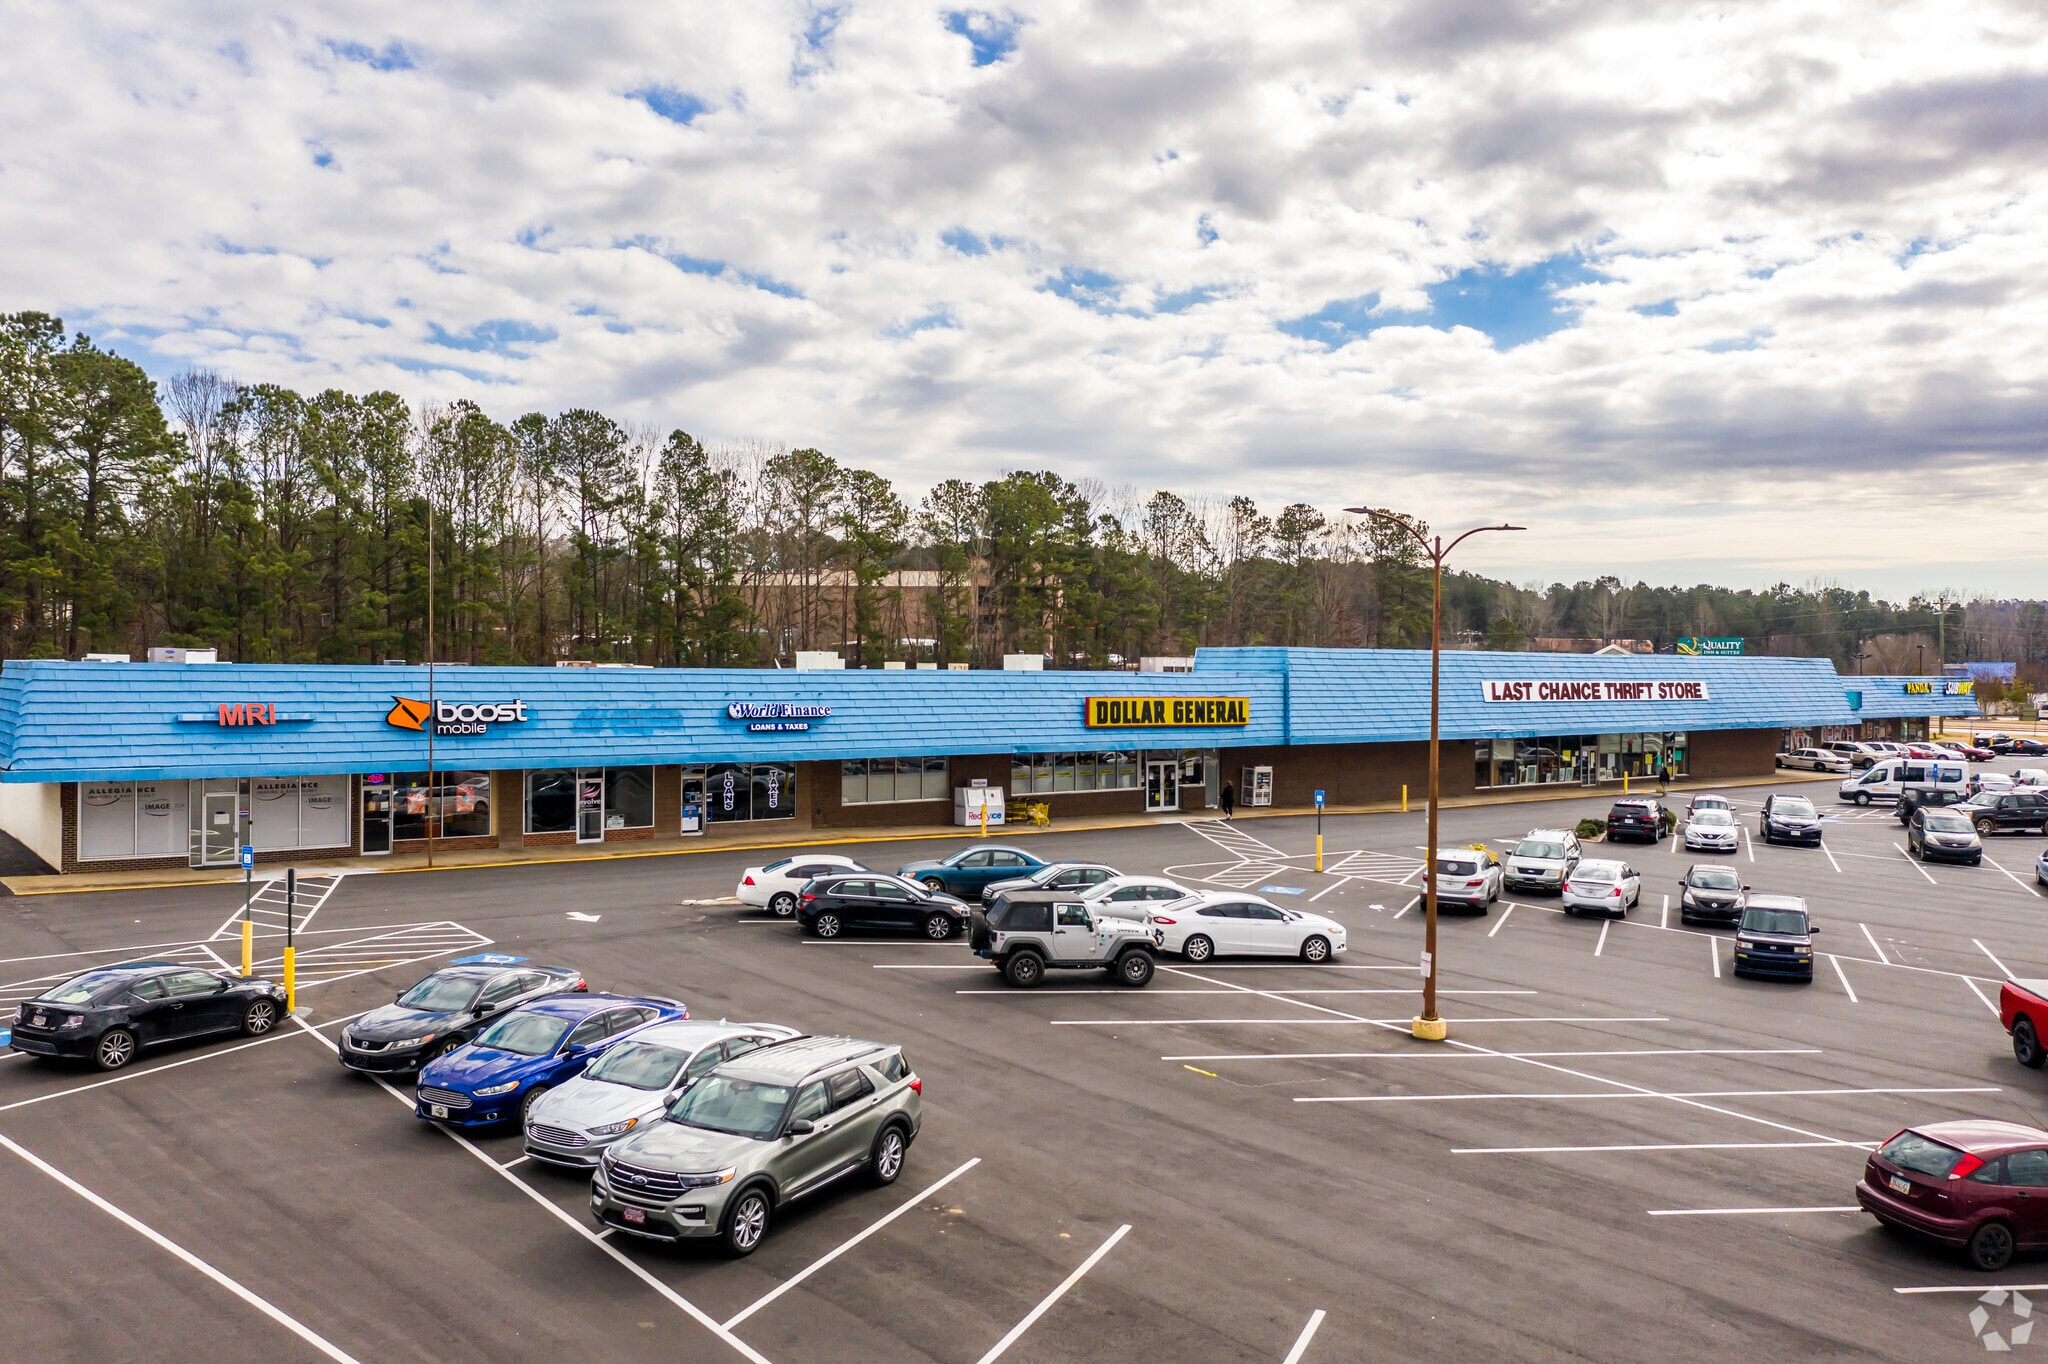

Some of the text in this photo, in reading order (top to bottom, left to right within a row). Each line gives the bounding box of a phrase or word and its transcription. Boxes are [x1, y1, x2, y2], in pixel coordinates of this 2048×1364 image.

[1702, 640, 1741, 650] QUALITY
[1491, 682, 1703, 700] LAST CHANCE THRIFT STORE
[1945, 682, 1973, 694] SUBWAY
[218, 703, 276, 726] MRI
[437, 699, 528, 722] boost
[740, 702, 832, 718] World Finance
[1096, 701, 1246, 724] DOLLAR GENERAL
[437, 723, 487, 735] mobile
[751, 723, 775, 731] LOANS
[88, 786, 156, 795] ALLEGIANCE
[257, 782, 318, 790] ALLEGIANCE
[725, 772, 733, 809] LOANS
[770, 771, 778, 807] TAXES
[969, 811, 991, 821] Redy
